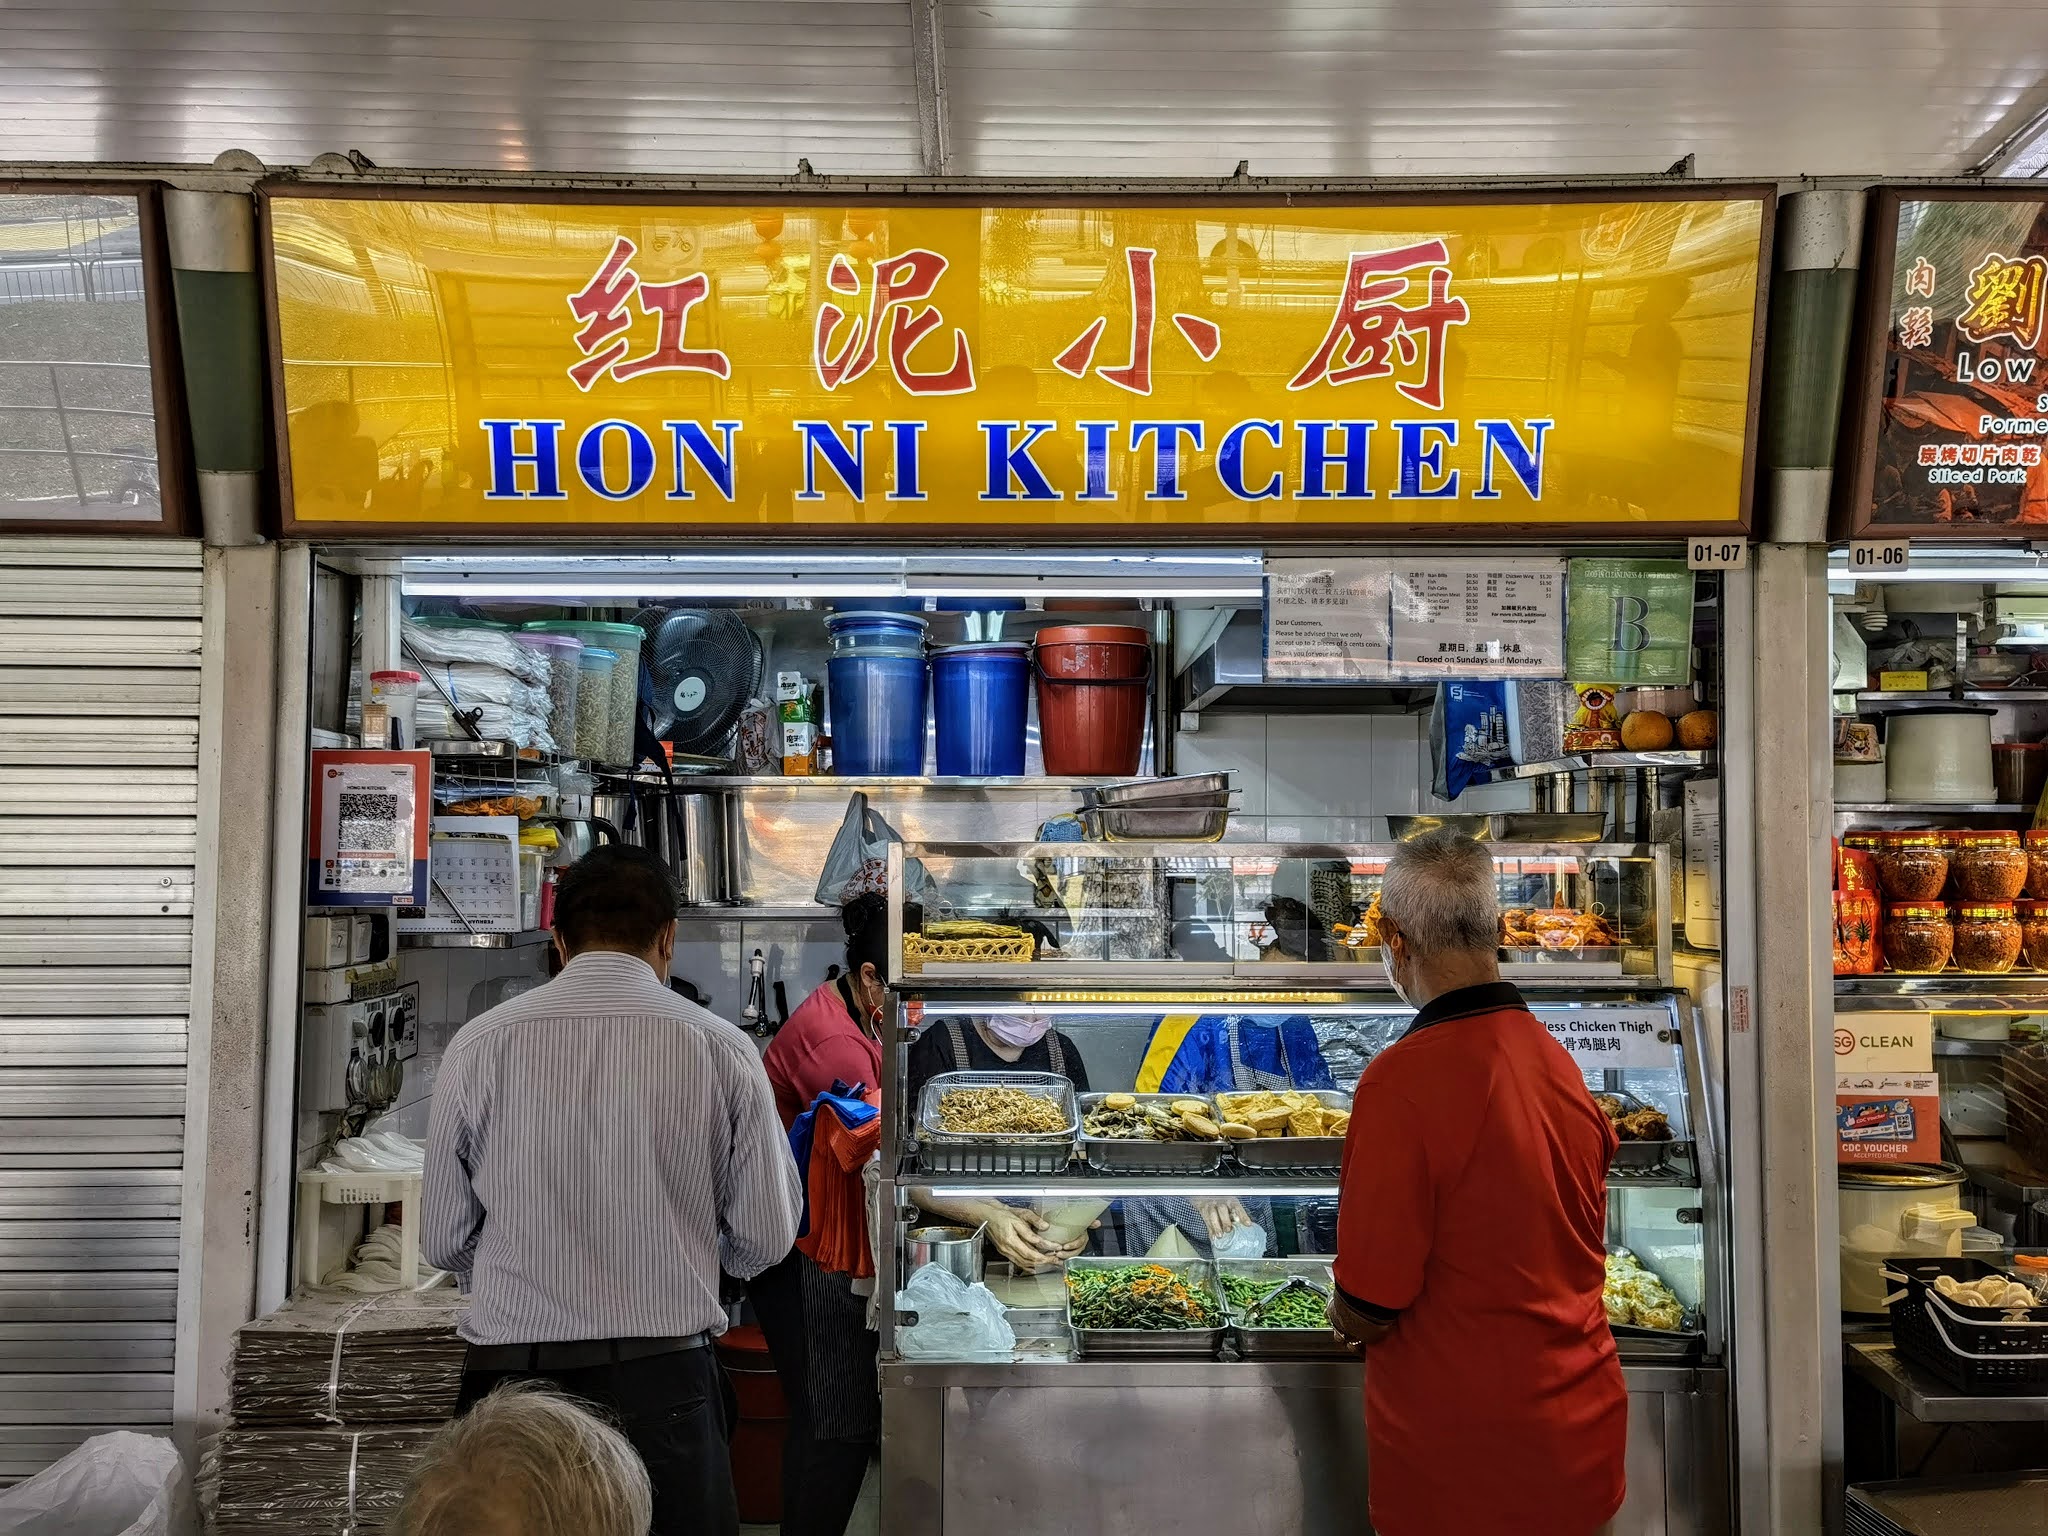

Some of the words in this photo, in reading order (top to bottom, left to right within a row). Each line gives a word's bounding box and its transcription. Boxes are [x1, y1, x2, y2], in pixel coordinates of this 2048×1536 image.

[1956, 253, 2048, 350] 劉
[567, 235, 1470, 410] 红泥小厨
[479, 418, 743, 501] HON
[792, 419, 928, 501] NI
[978, 419, 1555, 501] KITCHEN
[1918, 445, 2041, 466] 炭烤切片肉乾
[1928, 469, 1984, 483] Sliced
[1987, 469, 2027, 483] Pork
[1694, 545, 1740, 562] 01-07
[1856, 548, 1903, 565] 01-06
[1604, 596, 1651, 652] B
[1456, 656, 1488, 664] Sundays
[1569, 1021, 1616, 1032] Chicken
[1619, 1021, 1653, 1034] Thigh
[1834, 1036, 1851, 1047] SG
[1860, 1036, 1913, 1047] CLEAN
[1842, 1143, 1860, 1152] CDC
[1864, 1144, 1908, 1152] VOUCHER
